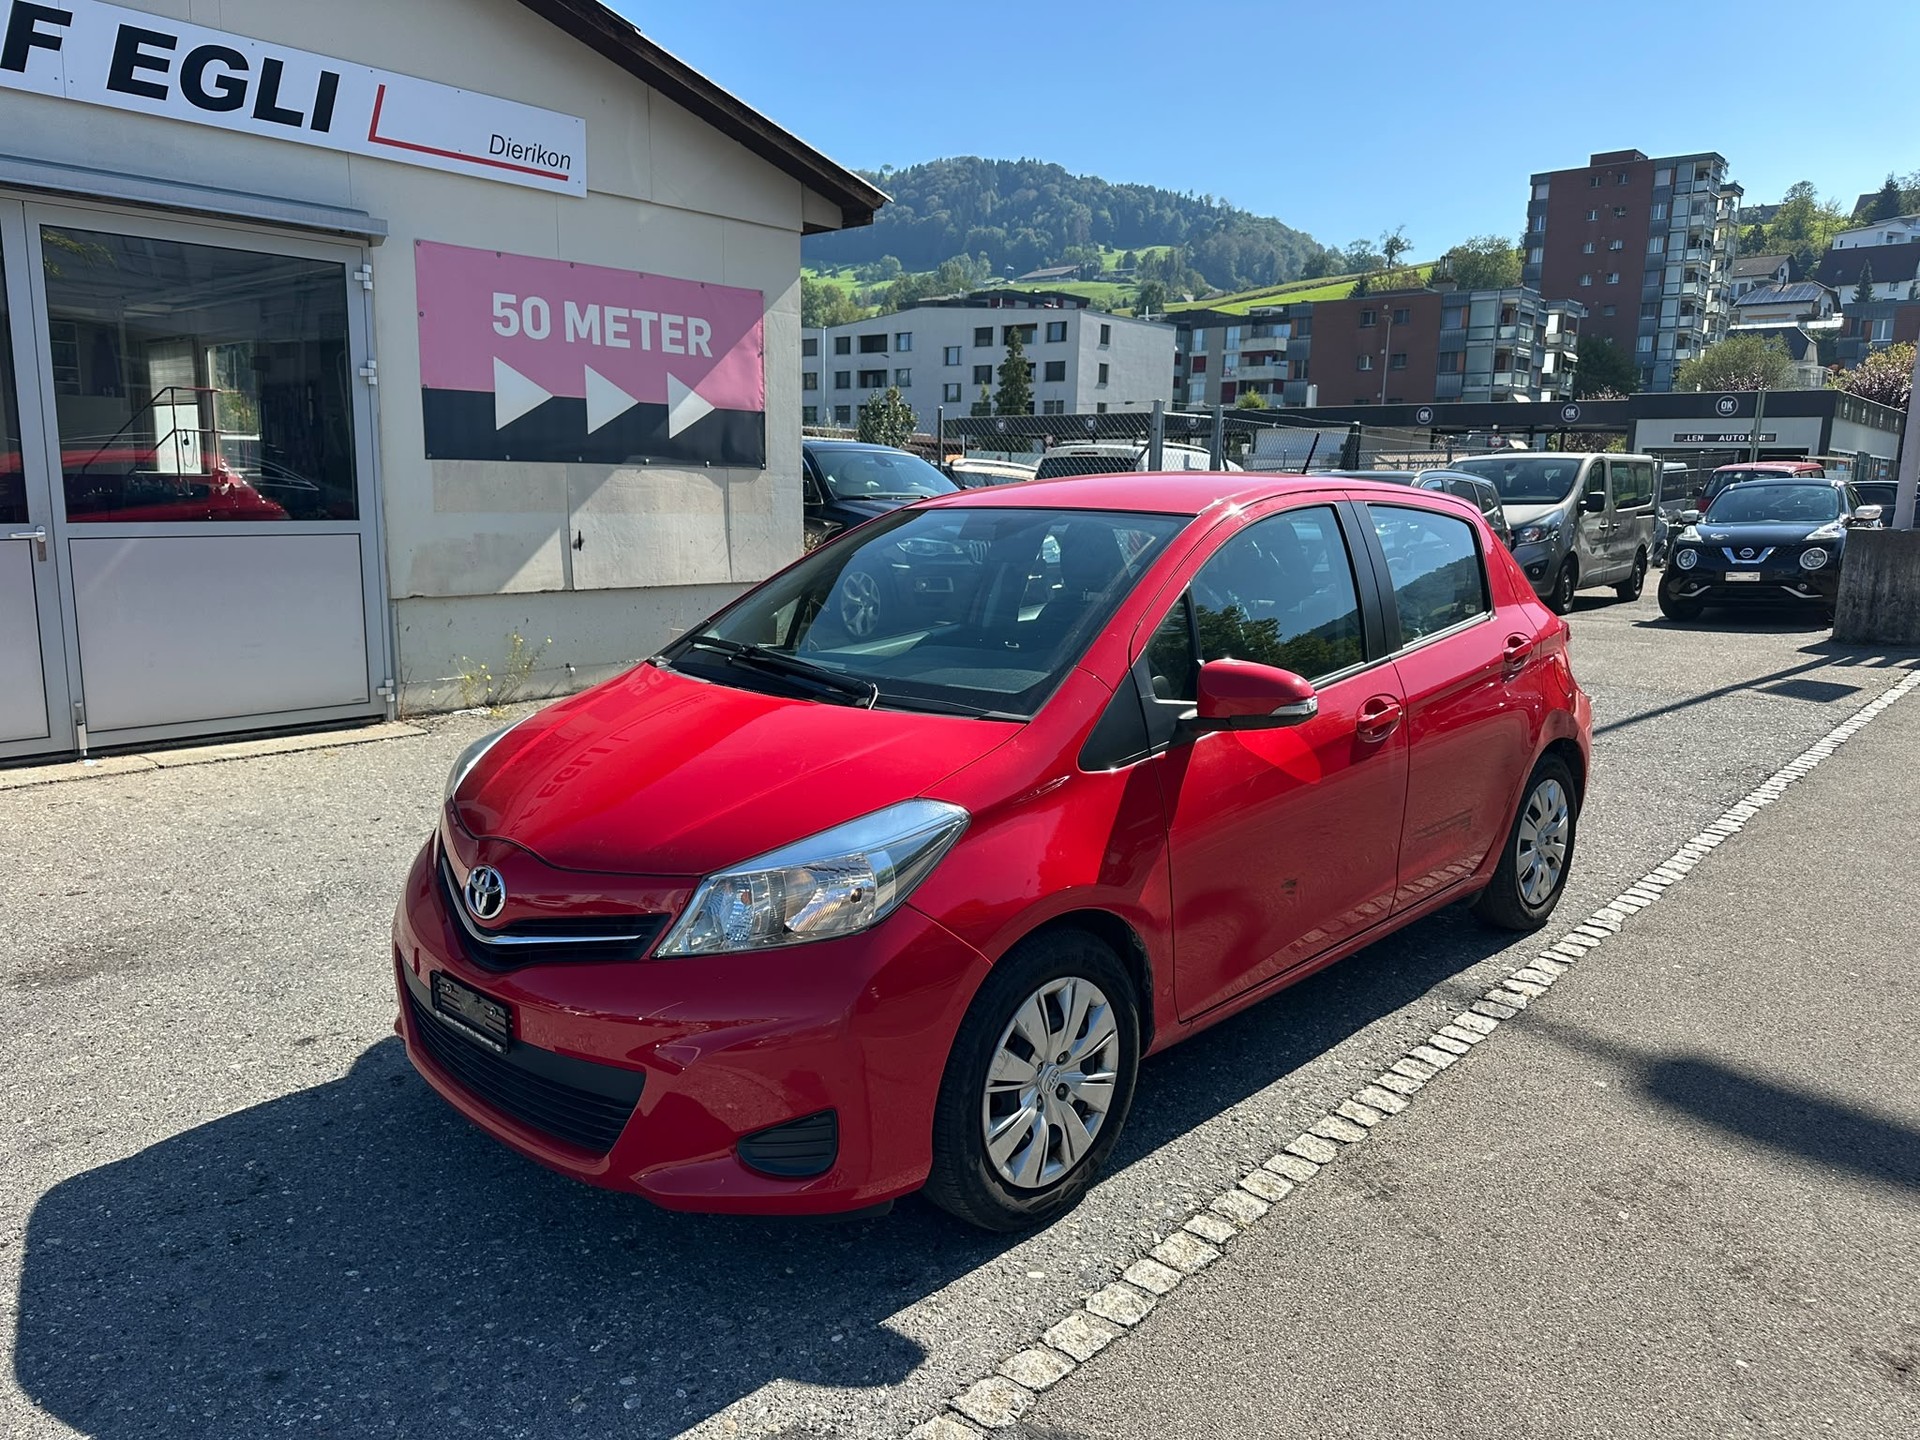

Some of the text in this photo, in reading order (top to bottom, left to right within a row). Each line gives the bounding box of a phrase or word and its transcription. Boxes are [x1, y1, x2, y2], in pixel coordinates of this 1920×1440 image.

[106, 23, 340, 133] EGLI
[489, 133, 571, 170] Dierikon
[492, 292, 713, 358] 50 METER
[1720, 400, 1734, 410] OK
[1718, 434, 1745, 442] AUTO
